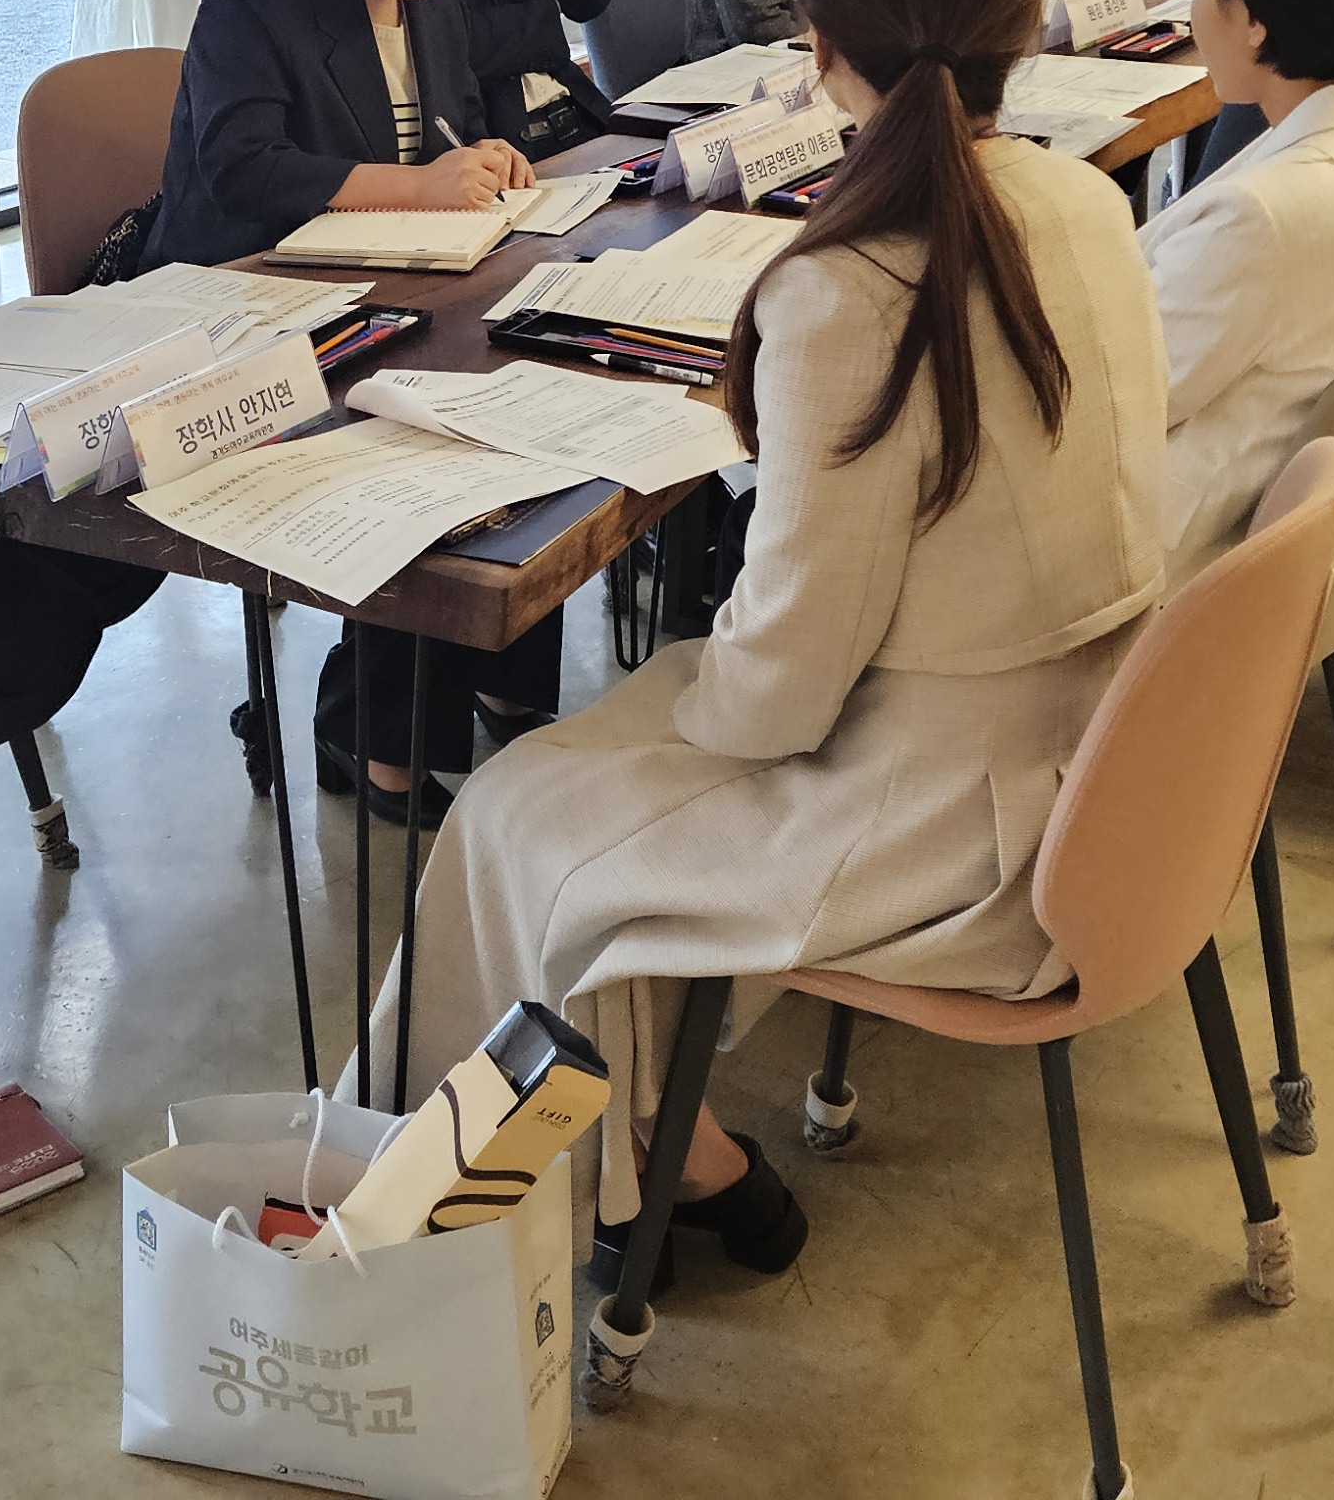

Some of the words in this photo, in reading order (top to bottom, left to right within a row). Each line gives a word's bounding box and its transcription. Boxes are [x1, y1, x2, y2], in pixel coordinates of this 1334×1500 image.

[744, 142, 806, 185] 문화공연팀장
[176, 406, 236, 455] 장학사
[239, 379, 295, 426] 안지현
[536, 1107, 572, 1124] GIFT
[198, 1346, 417, 1438] 공유학교
